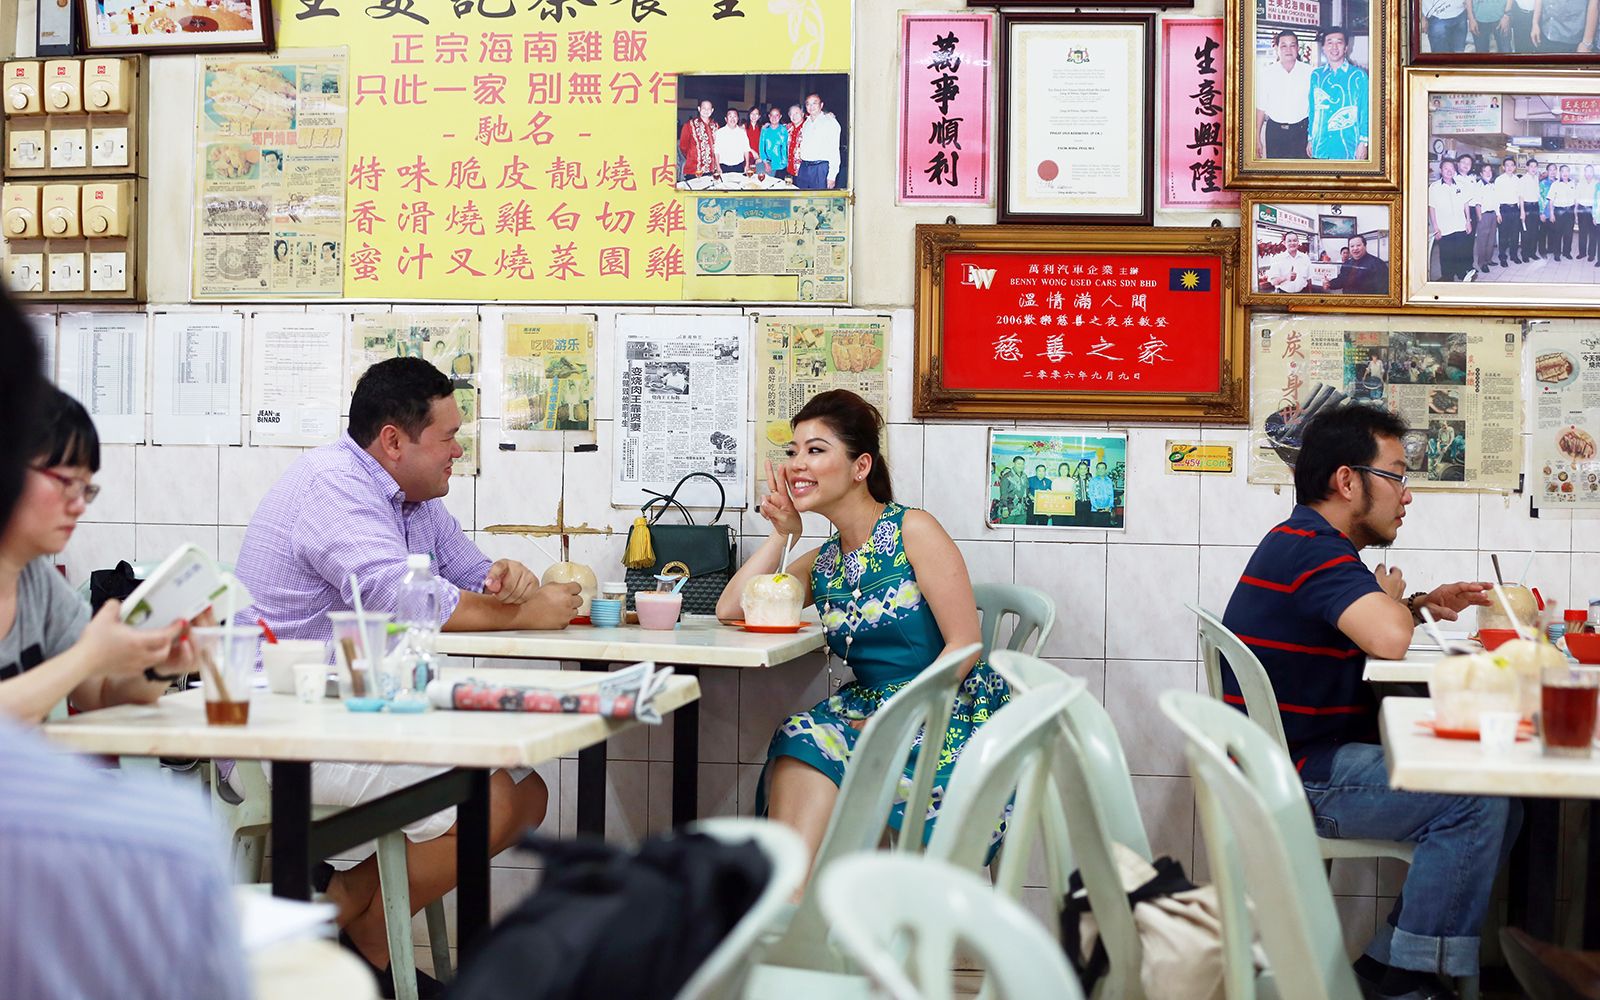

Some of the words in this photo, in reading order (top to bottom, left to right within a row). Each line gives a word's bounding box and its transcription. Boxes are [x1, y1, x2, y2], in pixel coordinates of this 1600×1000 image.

[391, 31, 647, 64] 正宗海南雞飯
[355, 73, 507, 105] 只此一家
[924, 31, 963, 187] 萬事順利
[1186, 36, 1223, 193] 生意興隆
[348, 155, 677, 193] 特味脆皮靚燒肉
[348, 199, 688, 236] 香滑燒雞白切雞
[349, 242, 687, 281] 蜜汁叉燒菜園雞
[1010, 278, 1037, 286] BENNY
[991, 332, 1174, 365] 慈善之家
